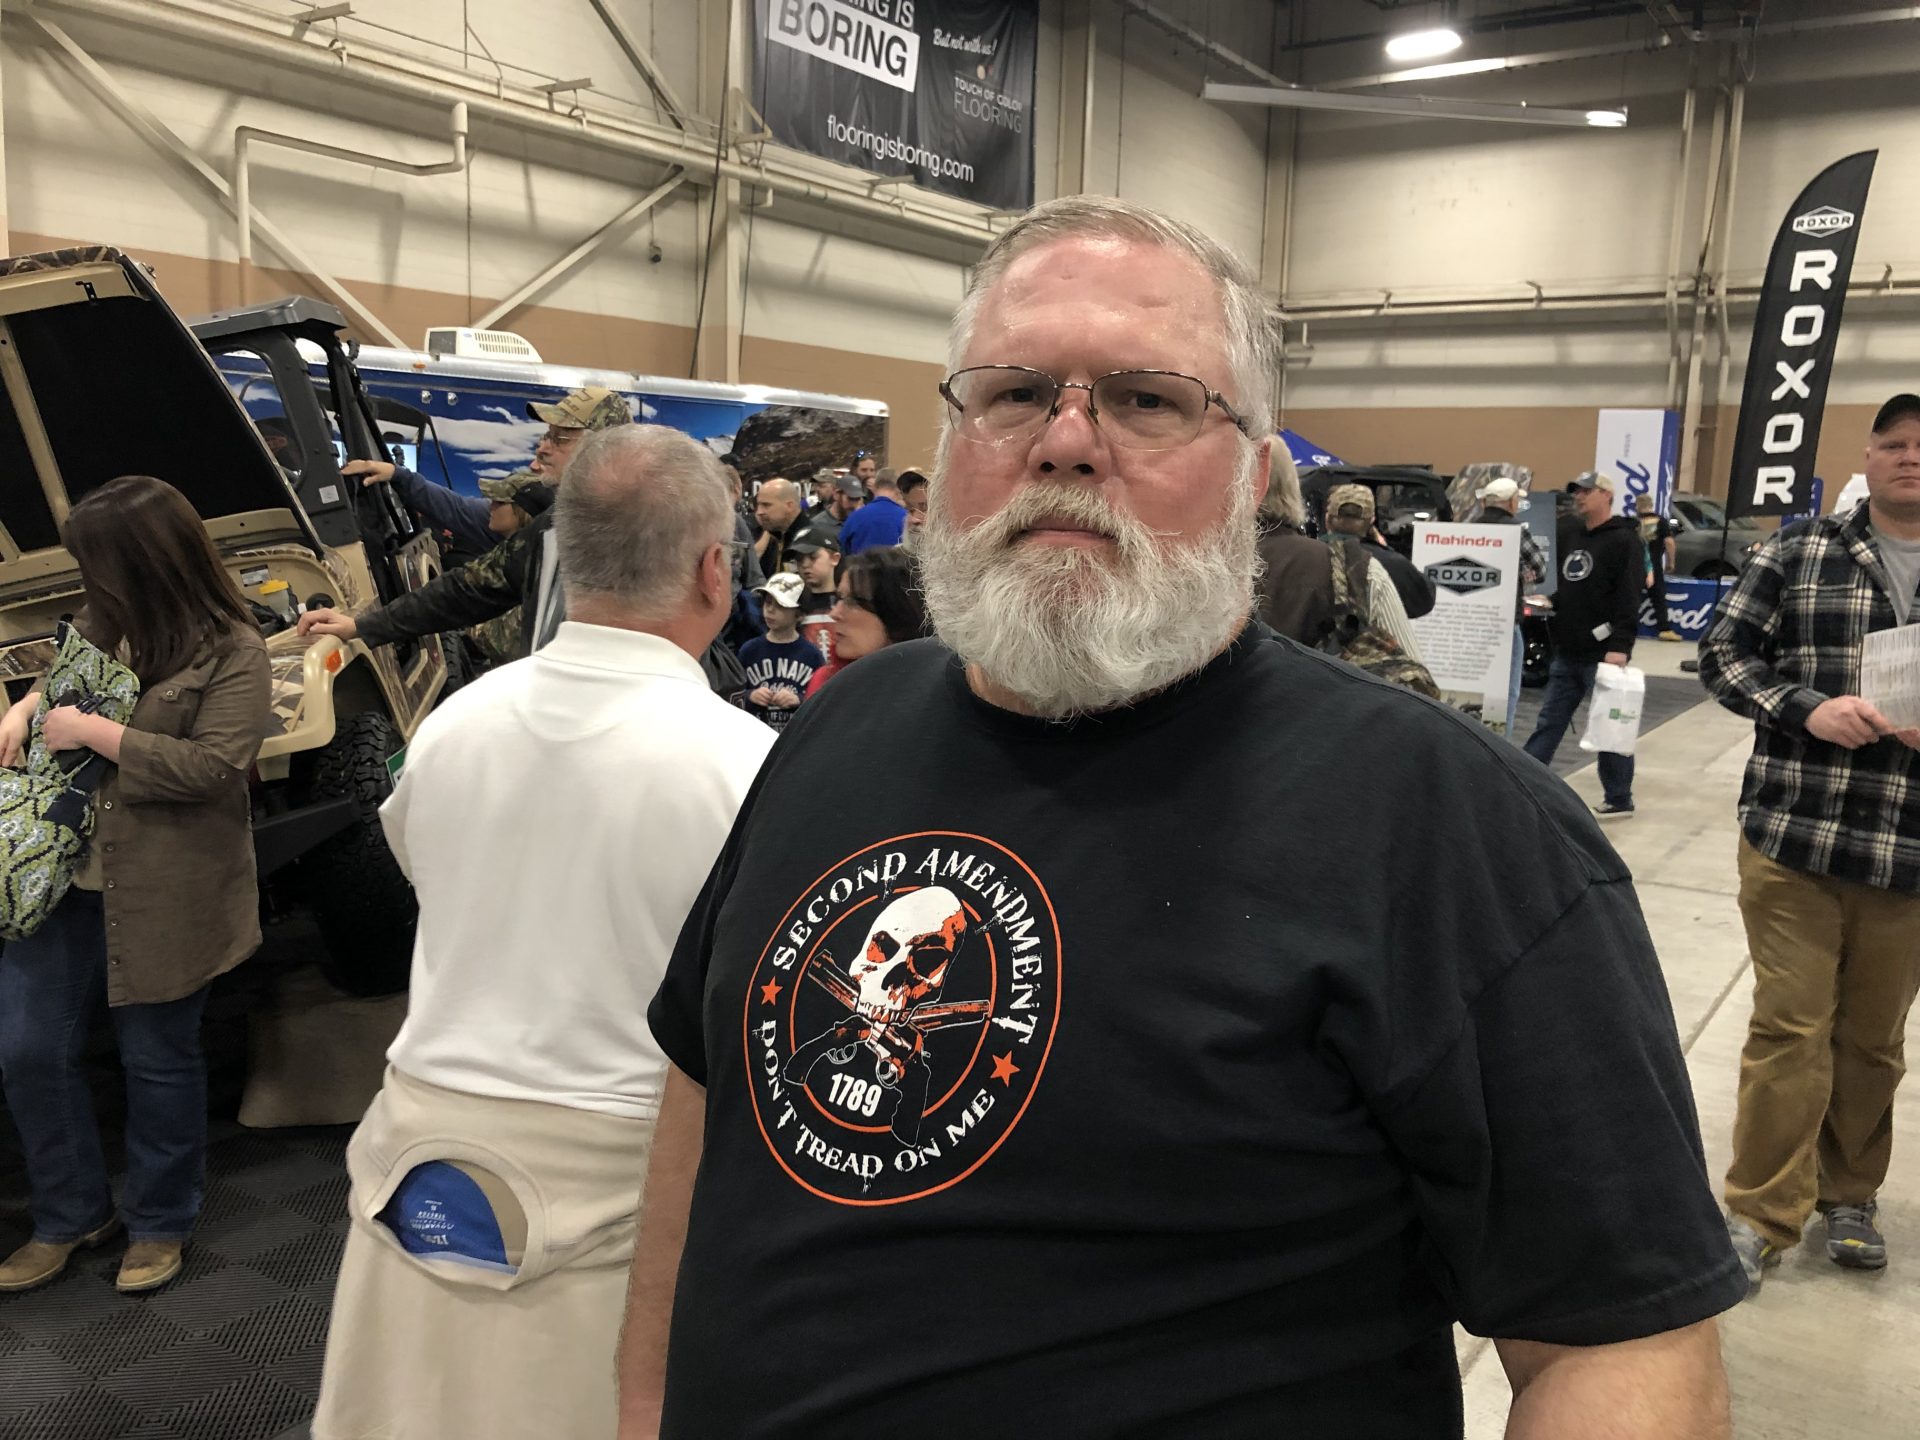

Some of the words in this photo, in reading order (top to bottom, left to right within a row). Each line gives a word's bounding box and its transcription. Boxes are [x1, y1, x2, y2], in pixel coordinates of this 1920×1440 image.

[895, 0, 914, 28] IS
[778, 0, 908, 78] BORING
[933, 28, 951, 48] But
[951, 34, 965, 51] not
[954, 76, 983, 97] TOUCH
[983, 88, 995, 102] OF
[997, 94, 1022, 112] COLOR
[954, 91, 1022, 134] FLOORING
[827, 114, 975, 184] flooringisboring.com
[1795, 215, 1852, 228] ROXOR
[1752, 249, 1838, 506] ROXOR
[1424, 533, 1503, 548] Mahindra
[1427, 568, 1499, 583] ROXOR
[1637, 590, 1713, 630] Frd
[746, 658, 774, 686] OLD
[777, 657, 813, 687] NAVY
[773, 851, 907, 971] SECOND
[915, 848, 1042, 1044] AMENDMENT
[828, 1072, 882, 1118] 1789
[795, 1123, 883, 1180] TREAD
[894, 1138, 943, 1173] ON
[945, 1088, 997, 1147] ME
